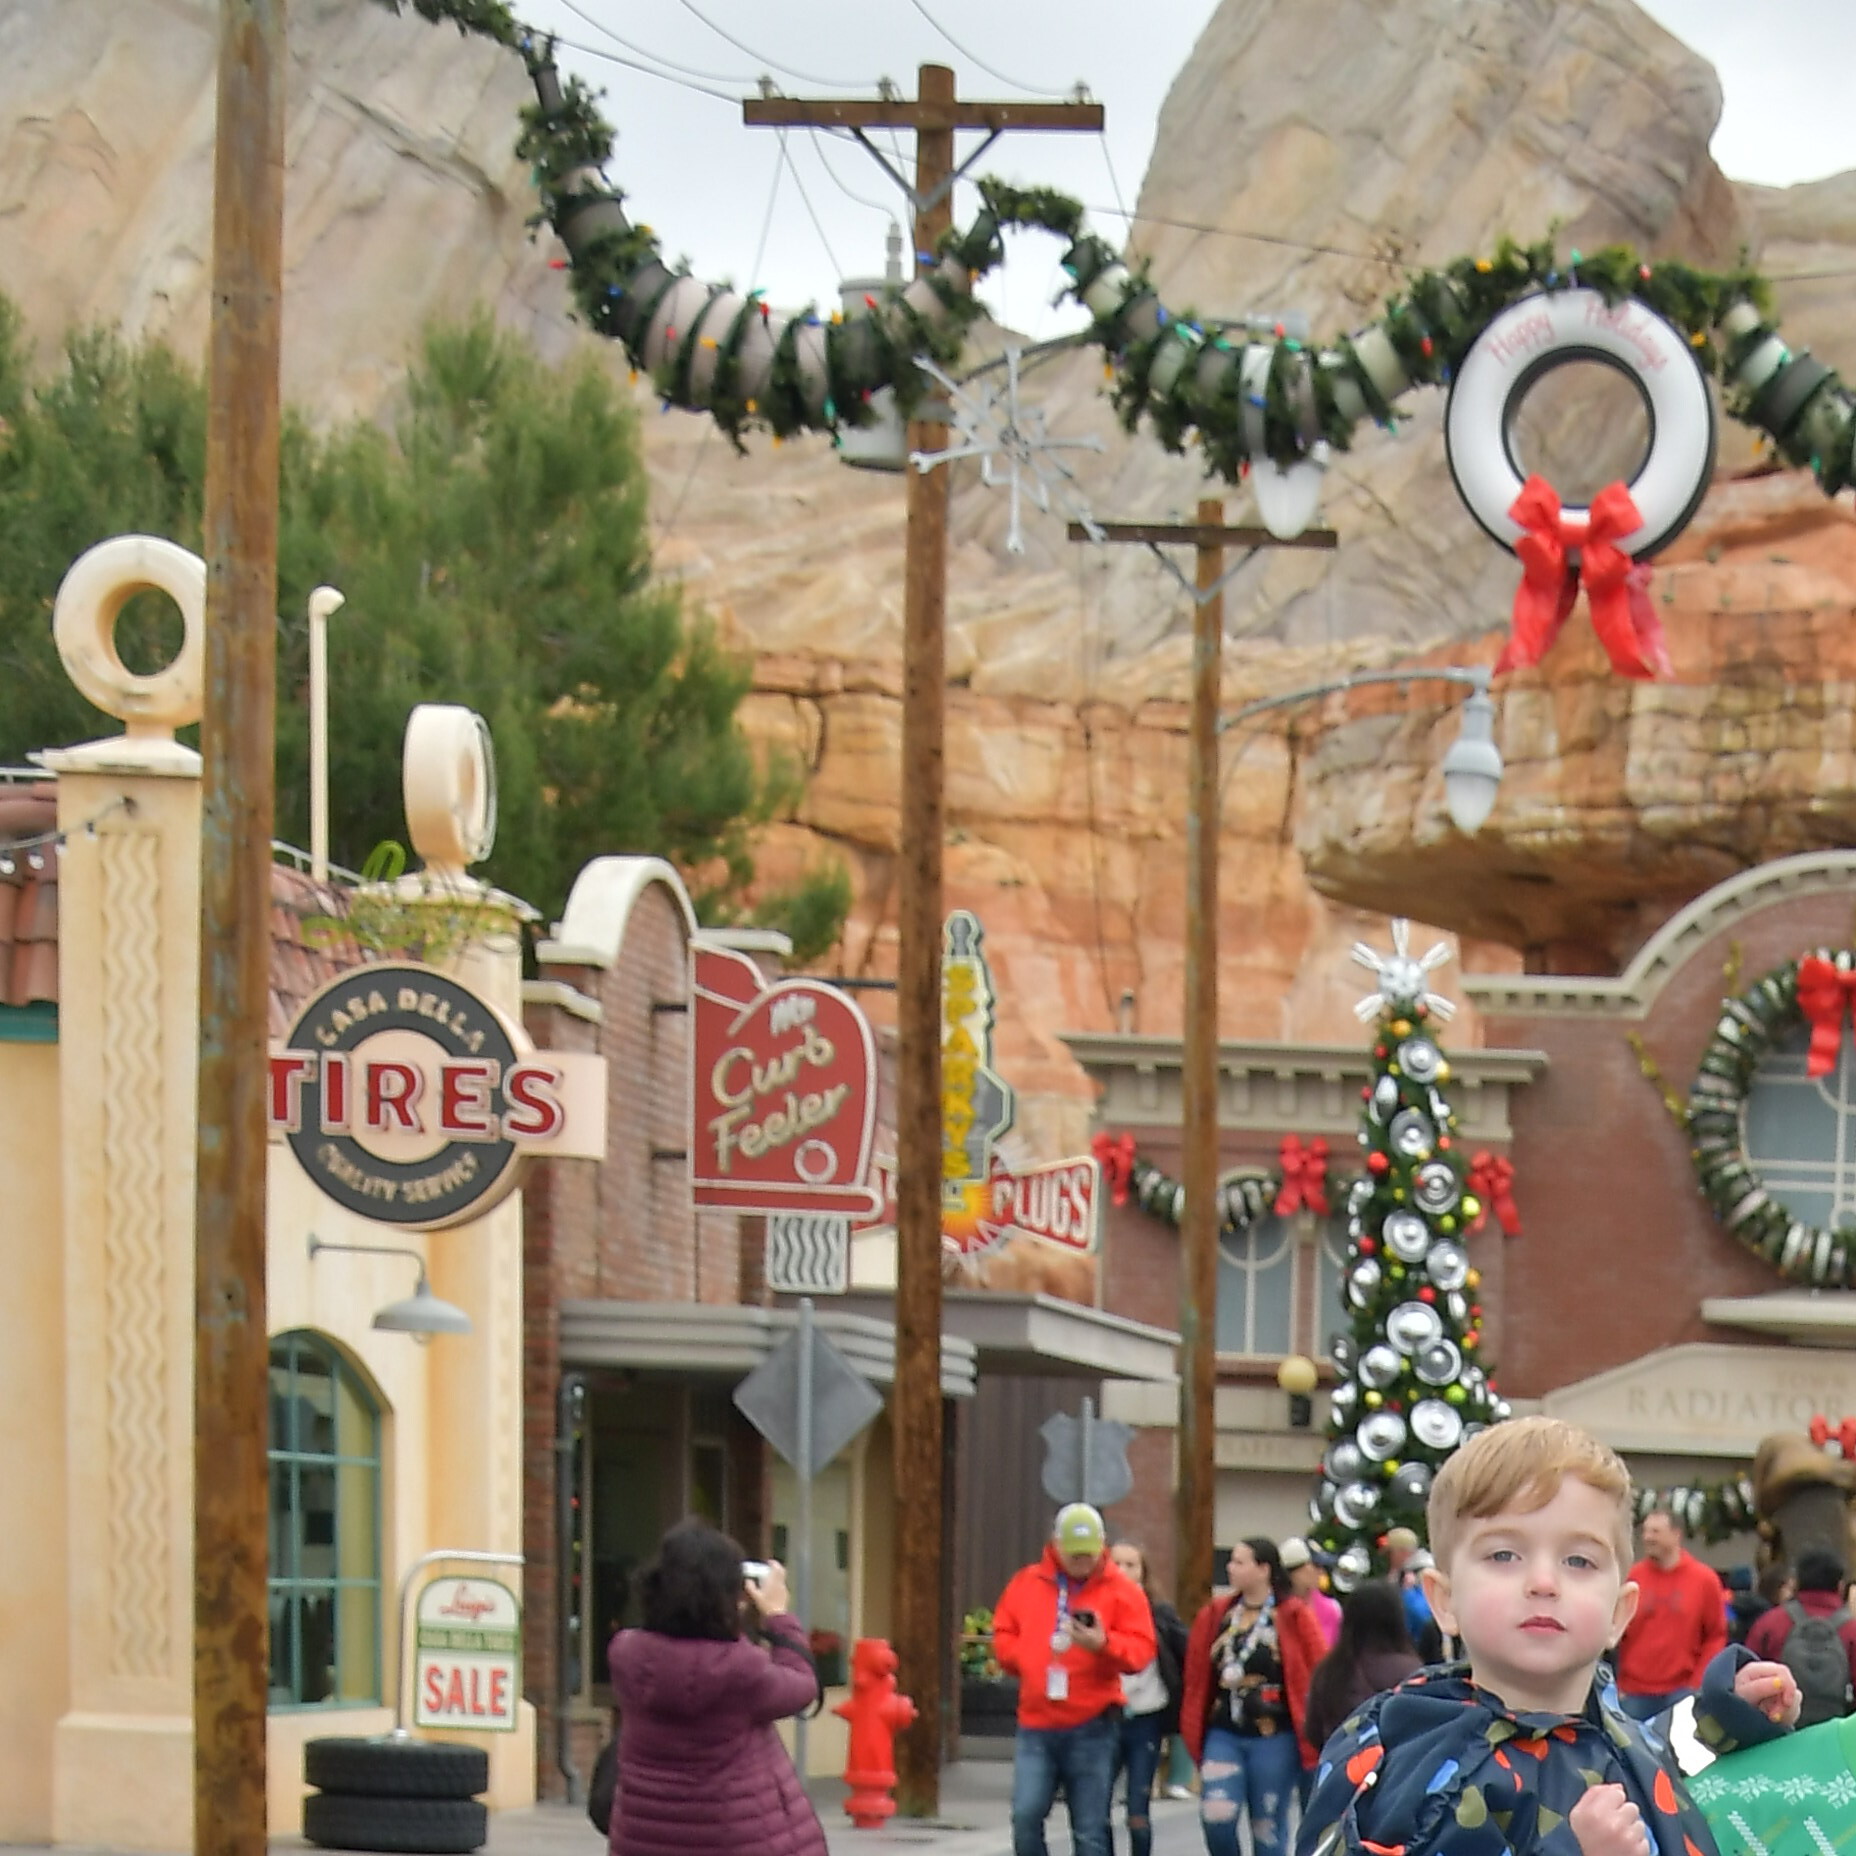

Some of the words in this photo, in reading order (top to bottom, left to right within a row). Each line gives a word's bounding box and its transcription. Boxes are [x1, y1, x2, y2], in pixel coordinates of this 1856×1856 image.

[315, 989, 388, 1048] CASA
[397, 986, 486, 1053] DELLA
[268, 1053, 564, 1140] TIRES
[710, 1022, 836, 1107] Curb
[707, 1082, 852, 1175] Feeler
[991, 1163, 1091, 1244] PLUGS
[1626, 1384, 1845, 1421] RADIATOR
[424, 1664, 508, 1717] SALE
